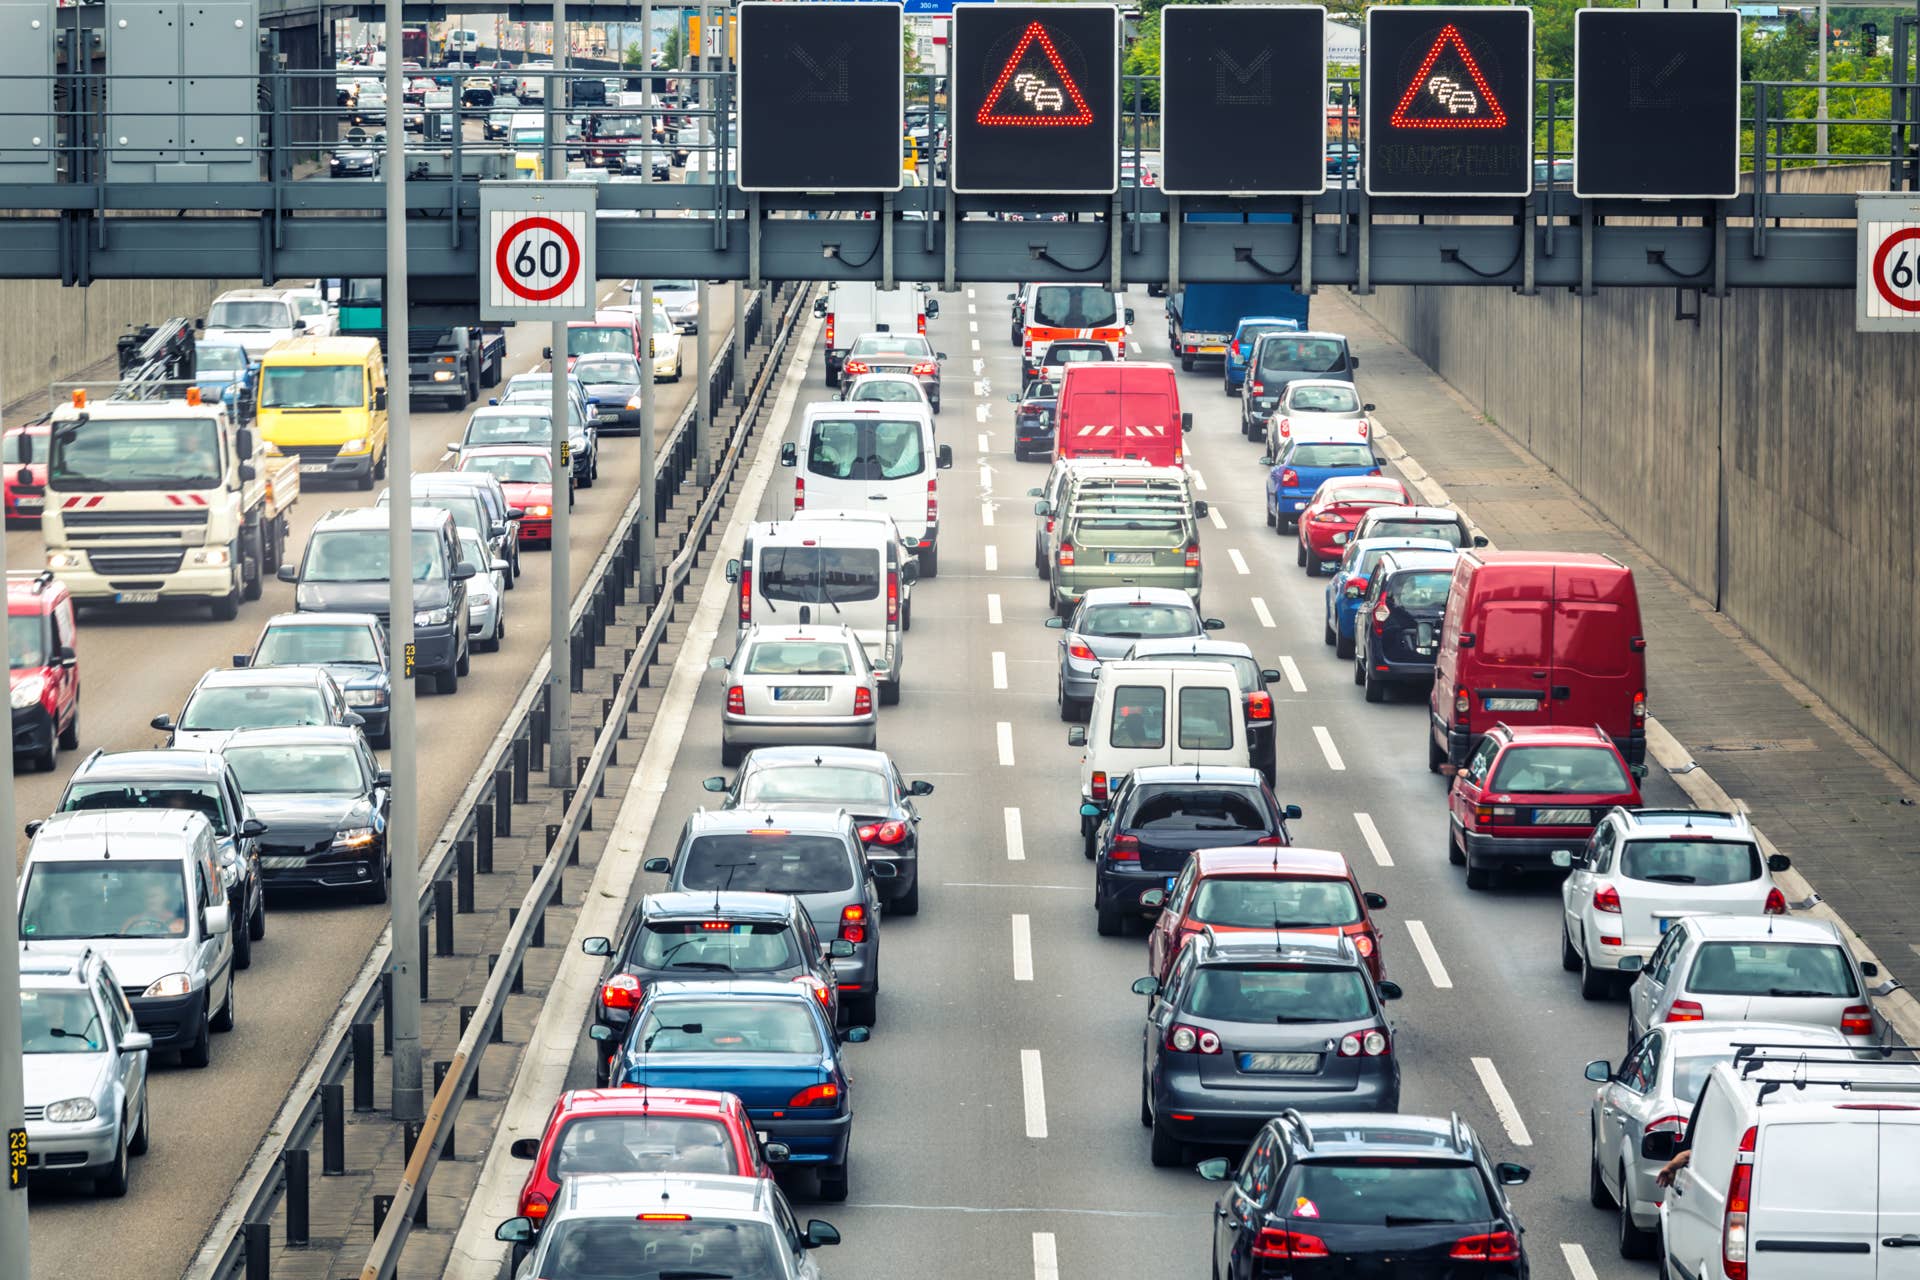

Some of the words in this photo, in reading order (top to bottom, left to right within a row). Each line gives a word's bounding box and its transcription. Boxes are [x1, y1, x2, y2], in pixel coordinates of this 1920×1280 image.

[515, 240, 561, 278] 60
[1891, 250, 1920, 289] 6
[406, 645, 416, 655] 23
[406, 655, 415, 666] 34
[10, 1131, 27, 1149] 23
[11, 1149, 27, 1167] 35
